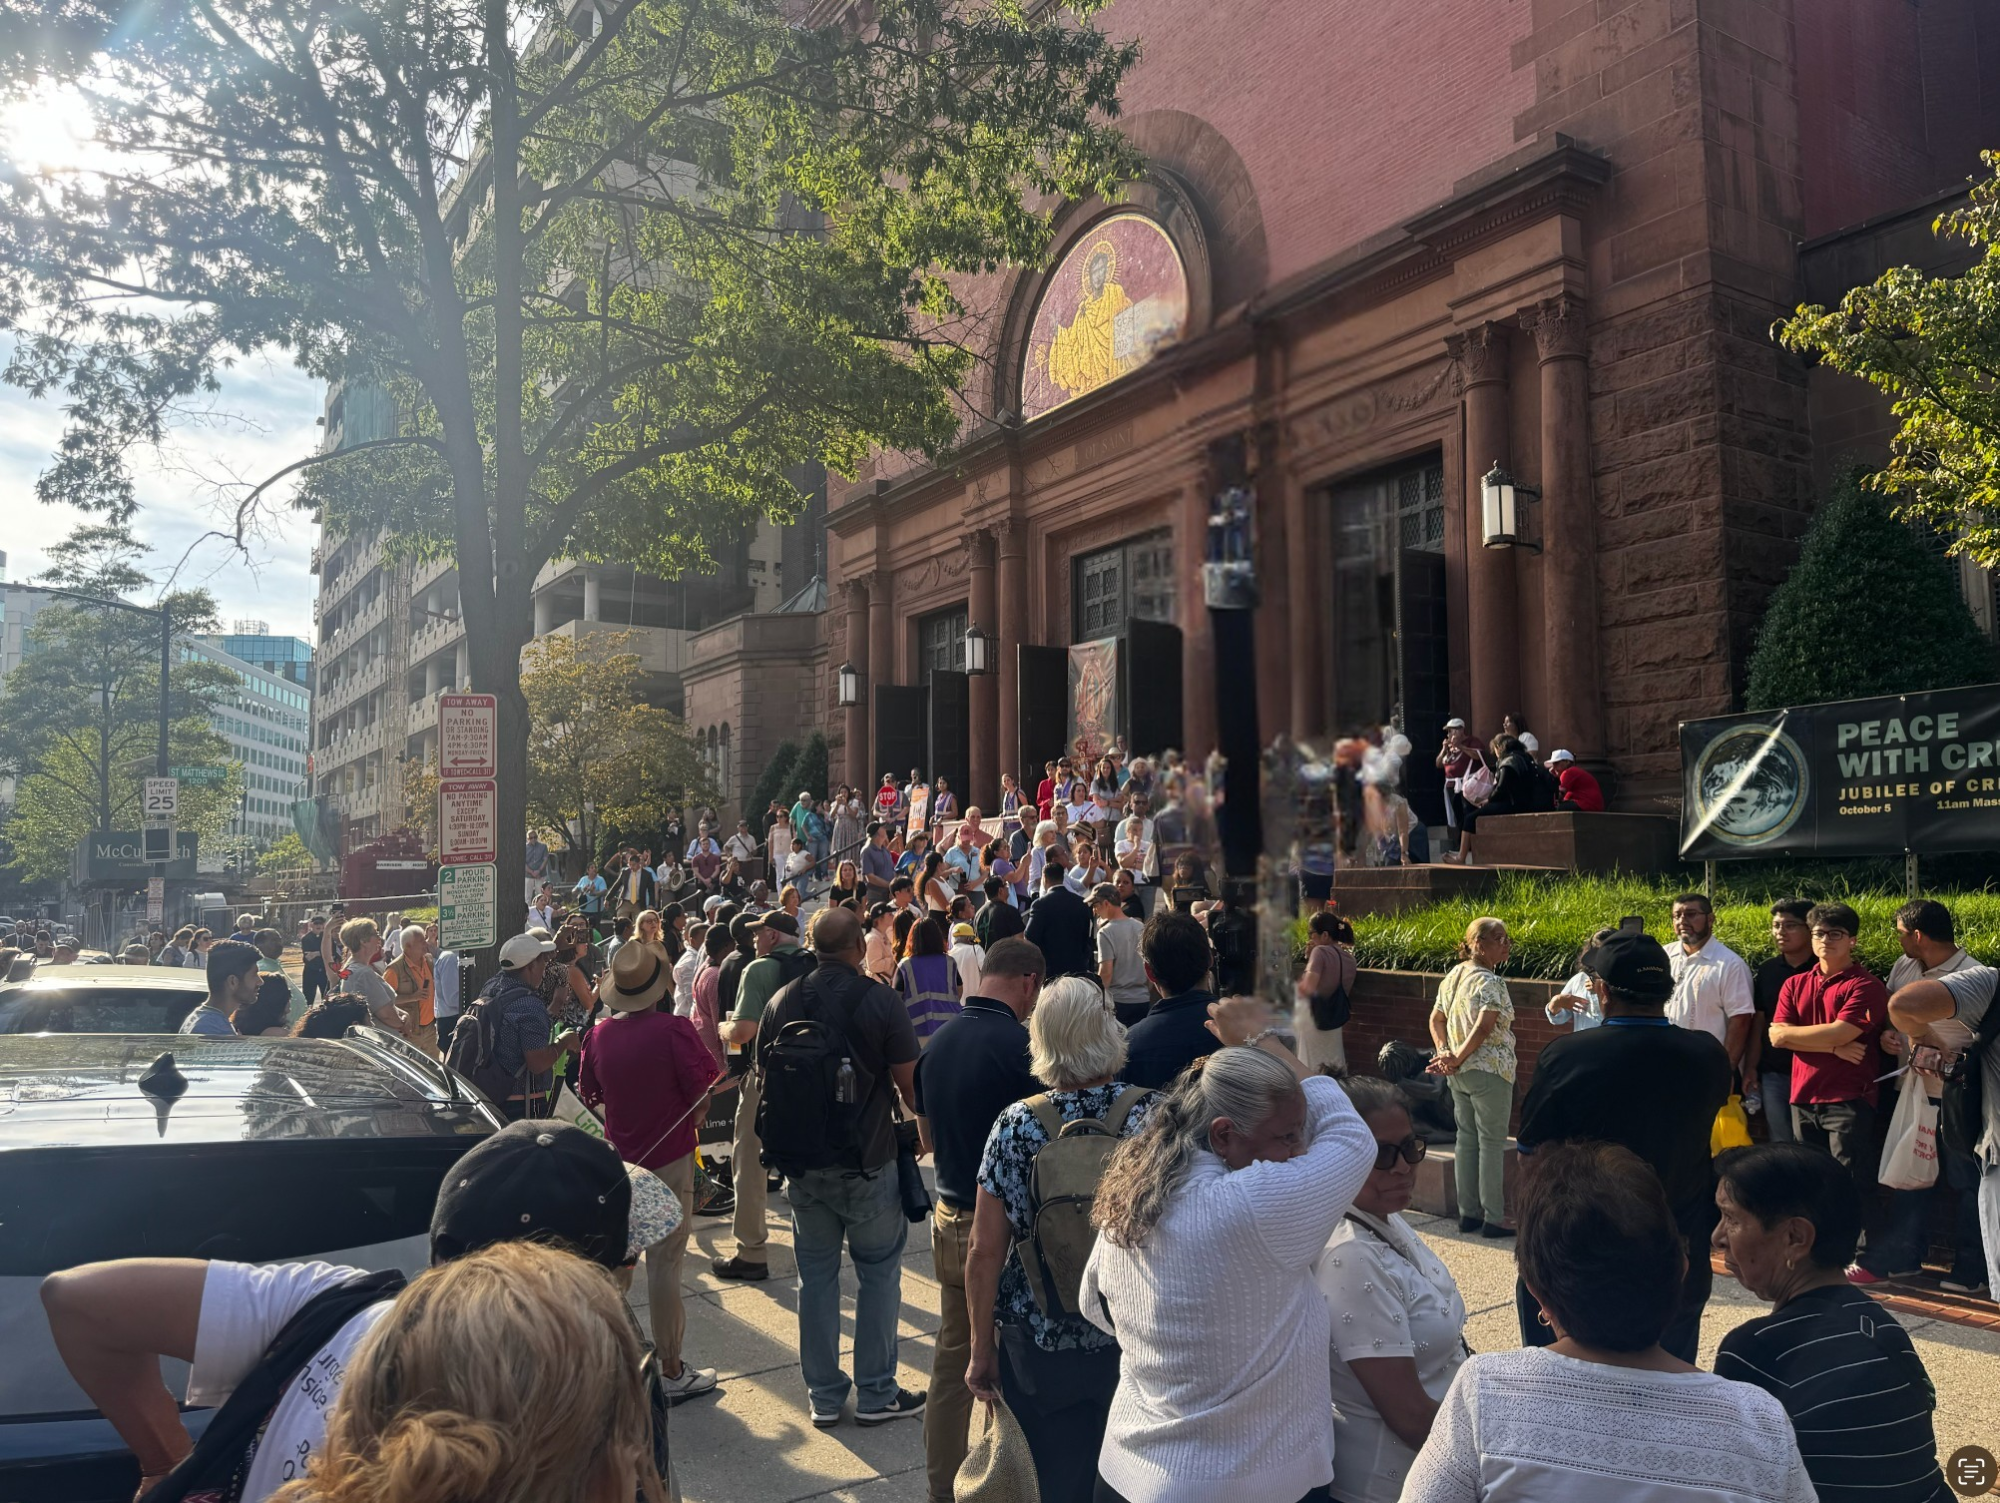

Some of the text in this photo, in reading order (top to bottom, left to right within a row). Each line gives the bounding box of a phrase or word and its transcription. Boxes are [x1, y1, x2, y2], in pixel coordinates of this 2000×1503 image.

[447, 698, 488, 706] TOW AWAY
[461, 709, 474, 717] NO
[447, 718, 488, 726] PARKING
[456, 726, 489, 734] STANDING
[1837, 712, 1959, 749] PEACE
[1836, 746, 1930, 779] WITH
[171, 768, 180, 777] ST
[181, 768, 218, 778] MATTHEWS
[148, 780, 176, 788] SPEED
[1838, 783, 1920, 801] JUBILEE
[1929, 779, 1956, 796] OF
[446, 791, 488, 801] NO PARKING
[879, 791, 896, 802] STOP
[148, 795, 174, 810] 25
[451, 799, 484, 808] ANYTIME
[1937, 799, 1970, 810] 11am
[457, 807, 478, 815] EXCEPT
[1839, 803, 1892, 815] October 5
[450, 814, 486, 823] SATURDAY
[457, 829, 480, 838] SUNDAY
[96, 843, 190, 861] McCugh
[444, 868, 485, 882] 2 HOUR
[457, 875, 491, 884] PARKING
[462, 904, 485, 912] HOUR
[457, 911, 491, 920] PARKING
[705, 1119, 727, 1129] Lime
